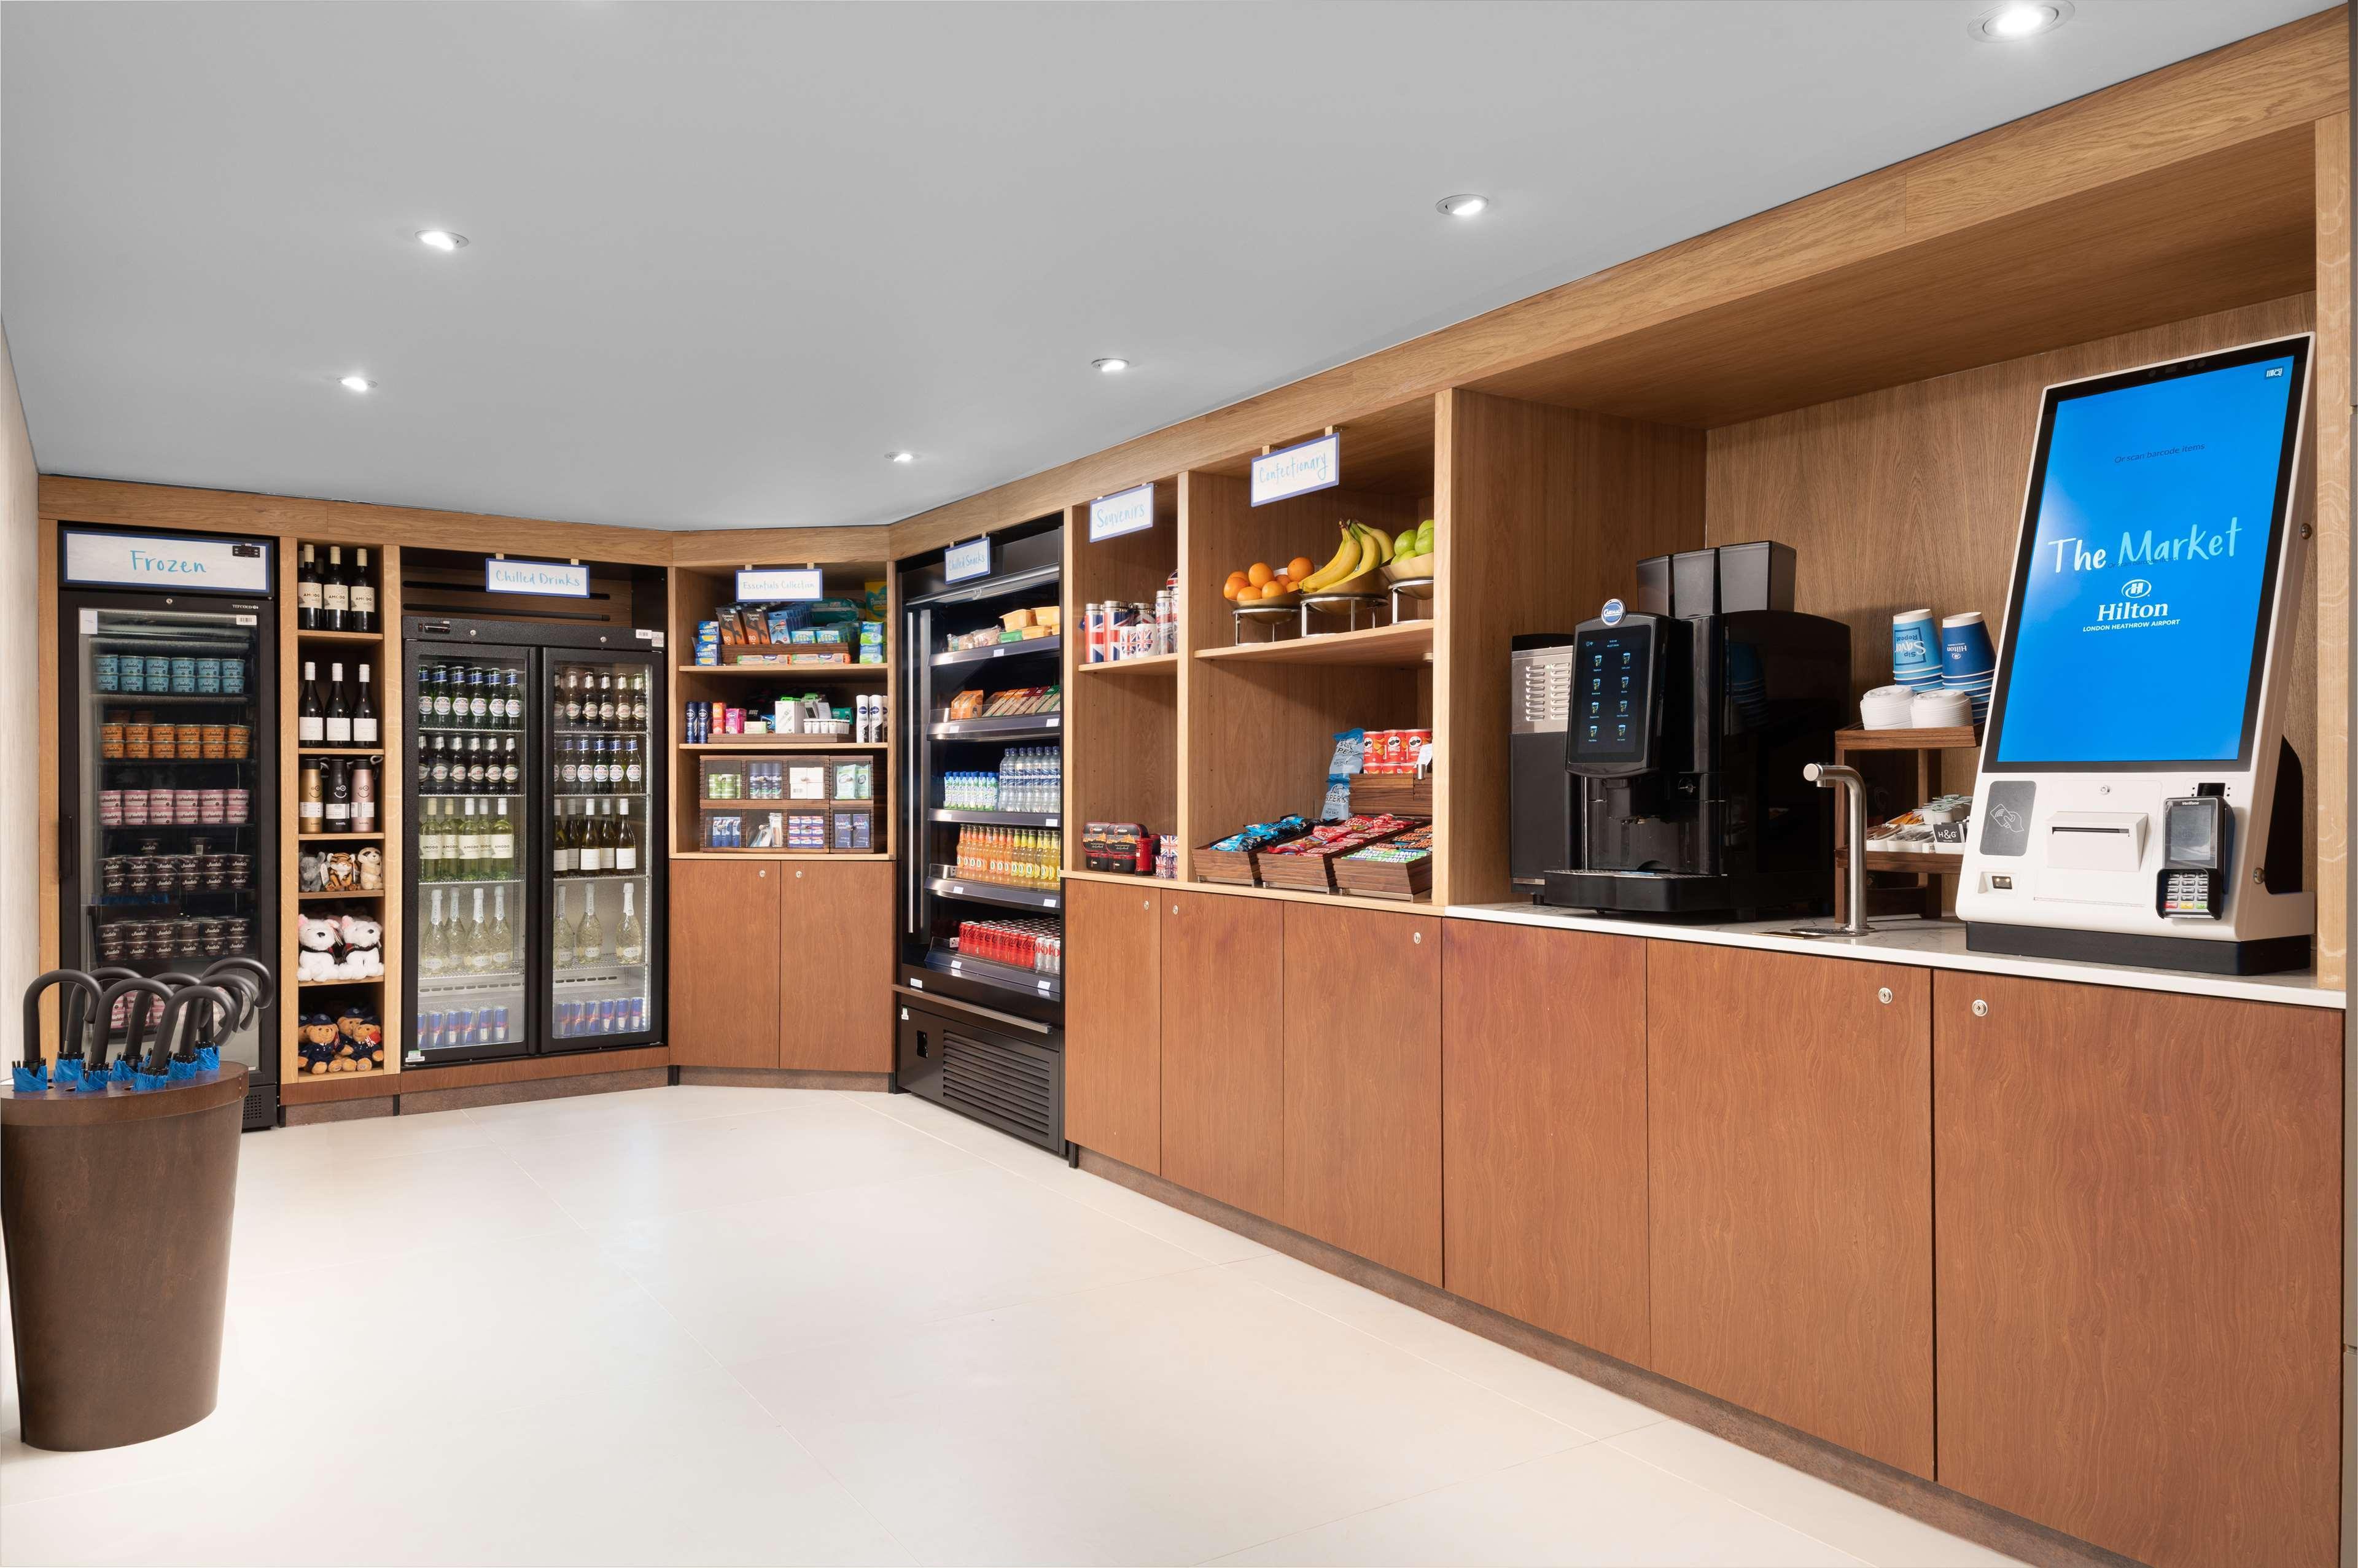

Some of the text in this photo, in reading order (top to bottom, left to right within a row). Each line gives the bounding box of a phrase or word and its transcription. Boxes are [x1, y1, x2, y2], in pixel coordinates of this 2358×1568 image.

[2114, 443, 2205, 464] Or scan barcode items
[1259, 452, 1328, 483] Confectionary
[1097, 503, 1145, 528] Souvenirs
[2048, 517, 2243, 573] The Market
[130, 550, 206, 573] Frozen
[496, 569, 580, 587] Chilled Drinks
[743, 580, 815, 590] Essentials Collection
[2097, 602, 2168, 621] Hilton
[2112, 621, 2150, 631] HEATHROW
[2150, 618, 2181, 627] AIRPORT
